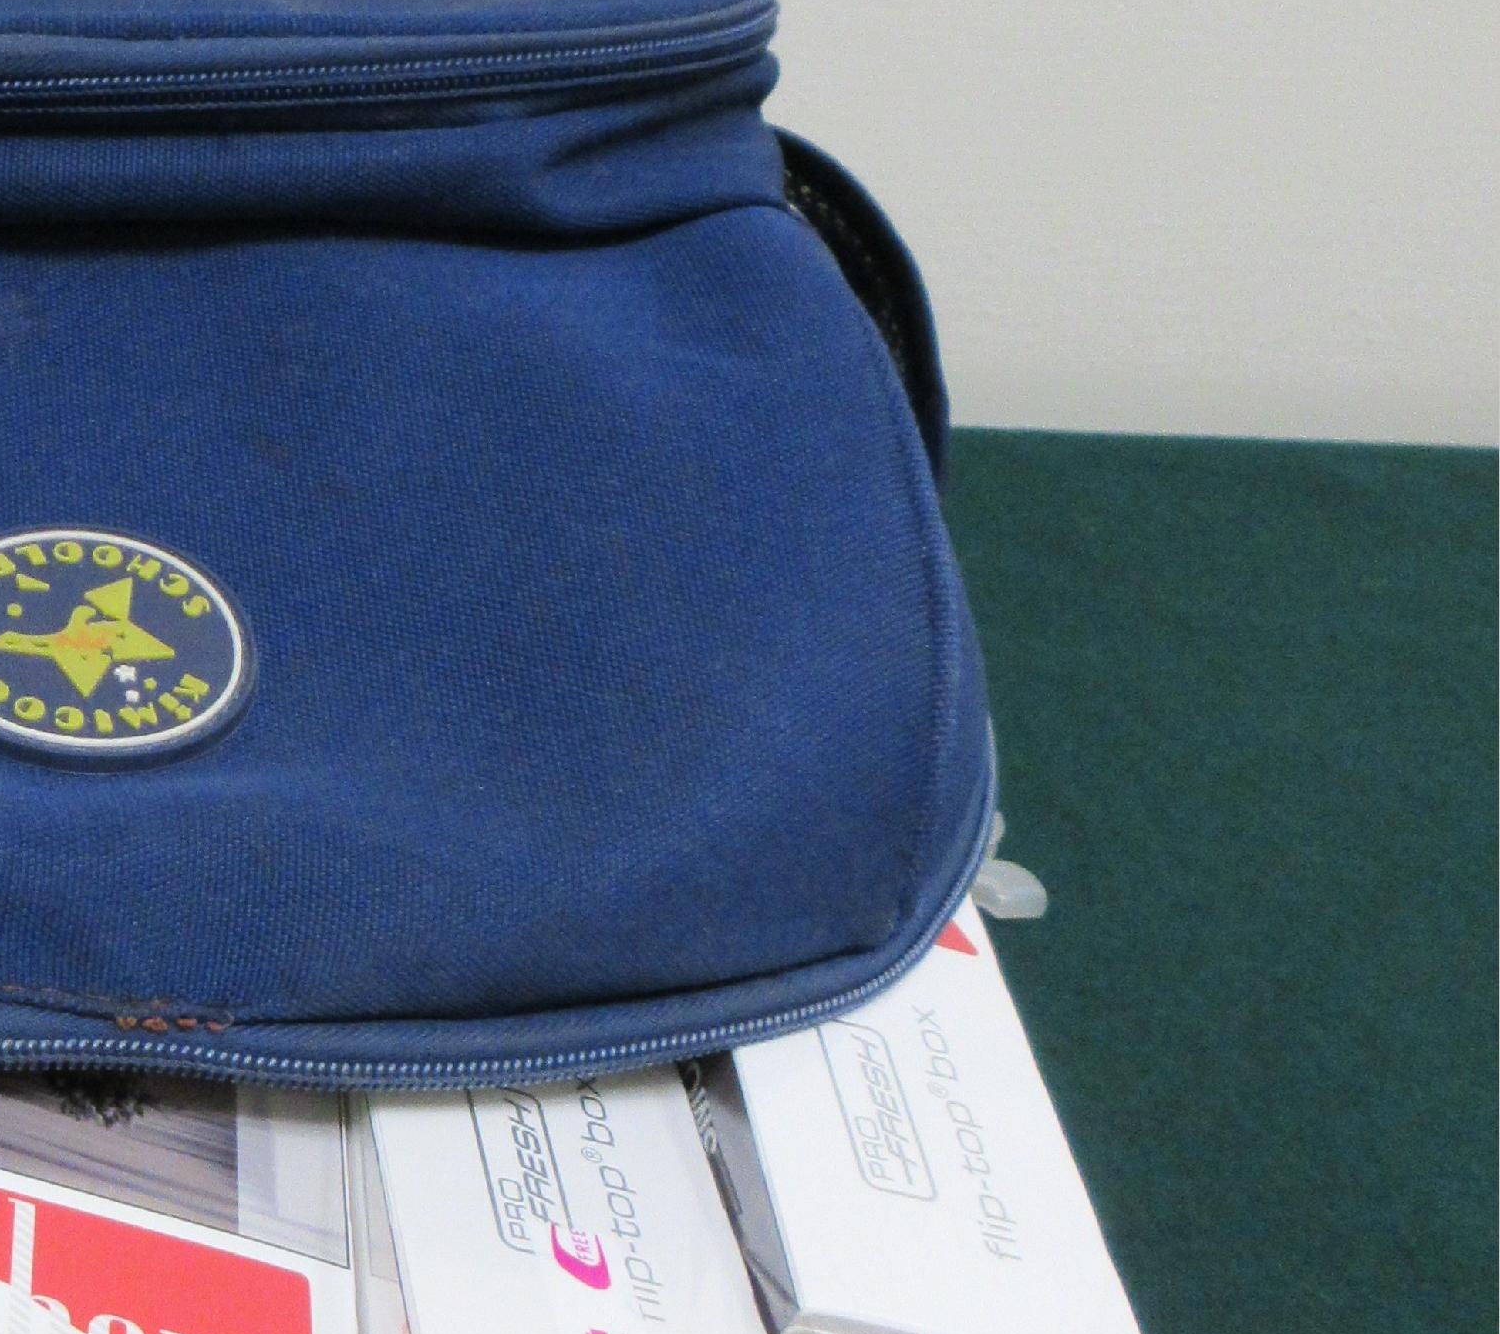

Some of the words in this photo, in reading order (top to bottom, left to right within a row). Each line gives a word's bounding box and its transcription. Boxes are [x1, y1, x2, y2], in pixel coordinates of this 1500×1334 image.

[852, 1033, 918, 1185] FRESH
[854, 1116, 894, 1182] PRO
[498, 1178, 531, 1241] PRO
[503, 1097, 560, 1227] FRESH
